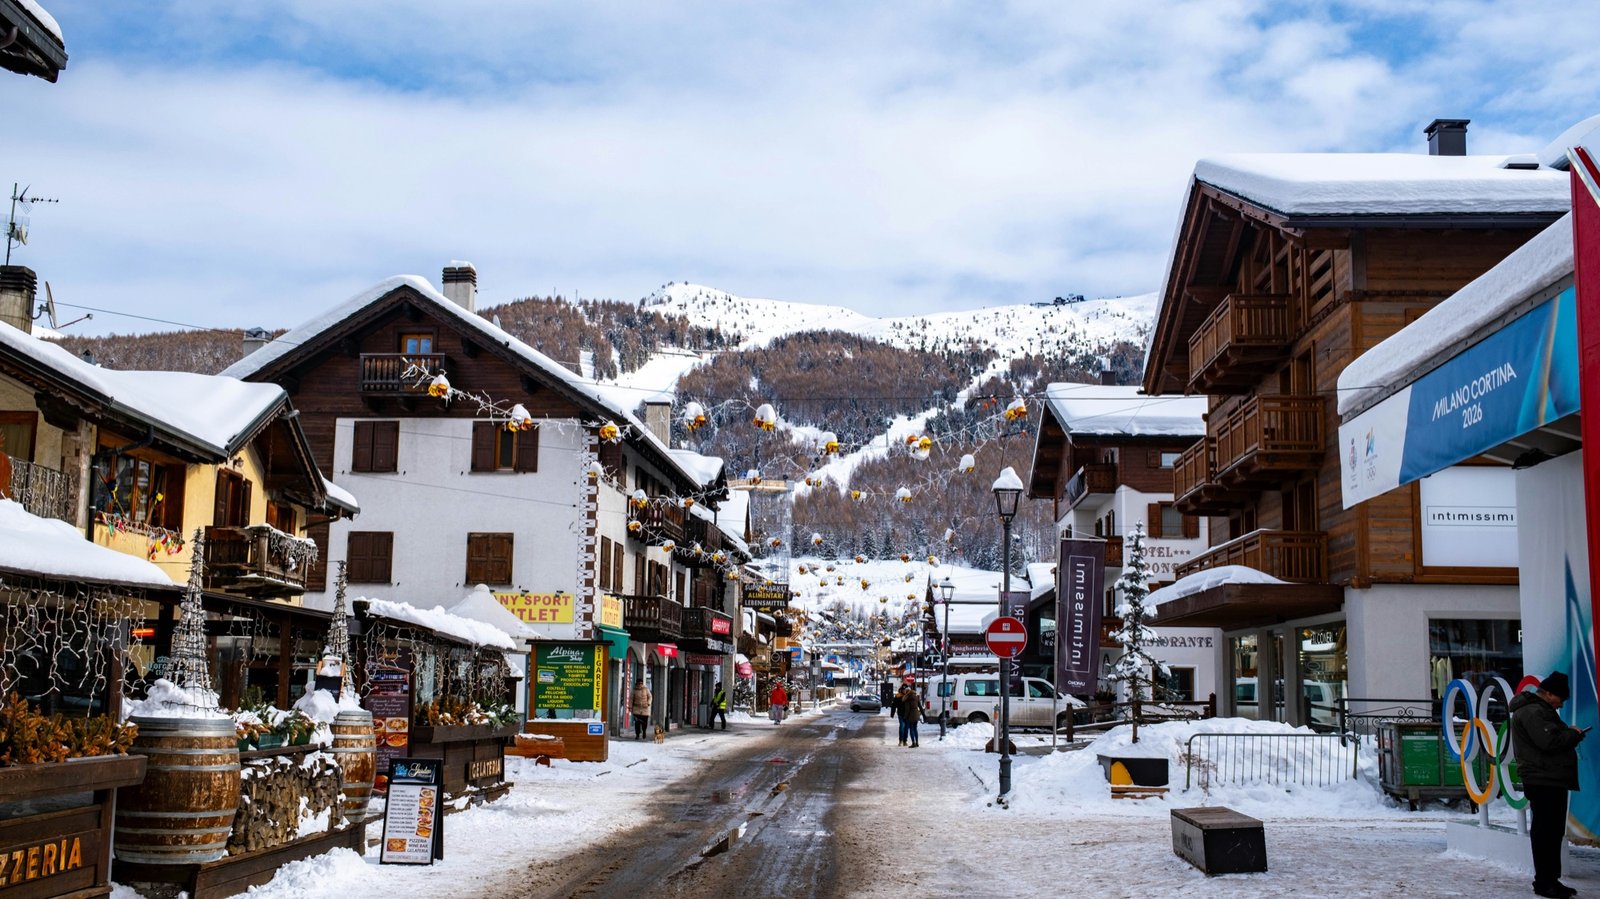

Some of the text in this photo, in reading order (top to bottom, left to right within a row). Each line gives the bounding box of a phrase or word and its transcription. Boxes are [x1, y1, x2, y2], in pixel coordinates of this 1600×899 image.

[1432, 362, 1517, 422] MILANO CORTINA
[1462, 402, 1483, 428] 2026
[1432, 511, 1514, 521] intimissimi
[1140, 546, 1173, 558] OTEL
[494, 595, 571, 606] NY SPORT
[513, 608, 559, 621] TLET
[550, 646, 580, 657] Alpina
[471, 760, 500, 778] GELATERIA
